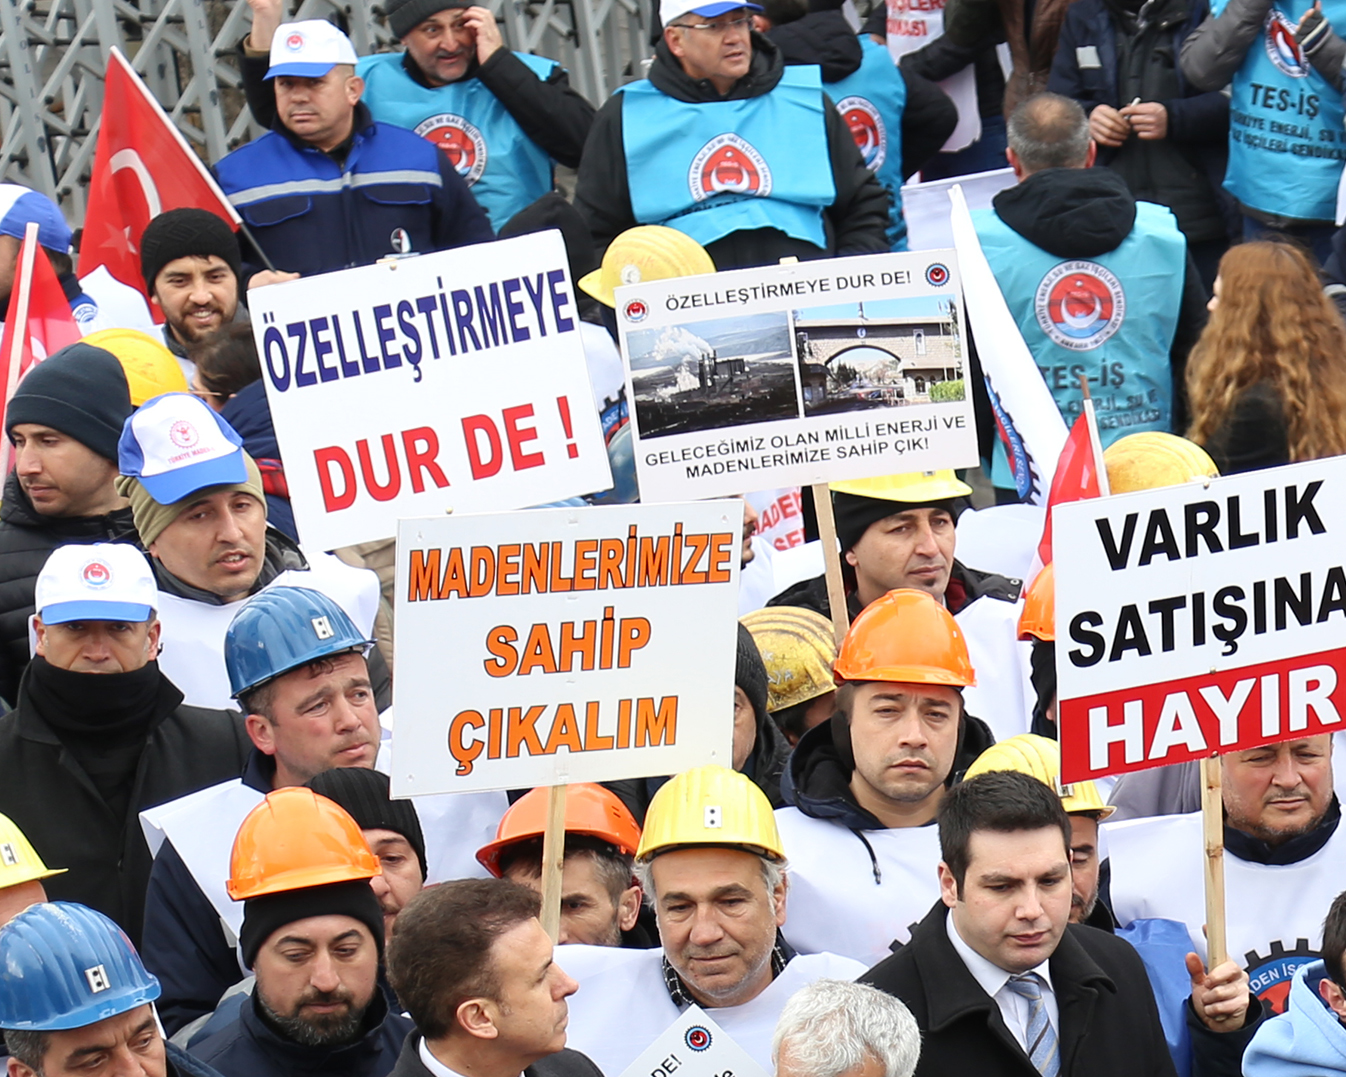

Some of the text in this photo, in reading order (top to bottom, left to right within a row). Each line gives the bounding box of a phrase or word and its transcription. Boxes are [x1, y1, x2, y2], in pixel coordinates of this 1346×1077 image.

[1250, 83, 1320, 121] TES-İŞ
[666, 270, 911, 311] ÖZELLEŞTİRMEYE DUR DE!
[263, 270, 574, 393] ÖZELLEŞTİRMEYE
[313, 426, 450, 513] DUR
[460, 403, 546, 481] DE
[645, 416, 966, 466] GELECEĞİMİZ OLAN MİLLİ ENERJİ VE
[686, 437, 929, 479] MADENLERİMİZE SAHİP ÇIK!
[408, 522, 734, 602] MADENLERİMİZE
[1095, 480, 1326, 571] VARLIK
[484, 605, 651, 678] SAHİP
[448, 695, 679, 776] ÇIKALIM
[1087, 664, 1341, 770] HAYIR
